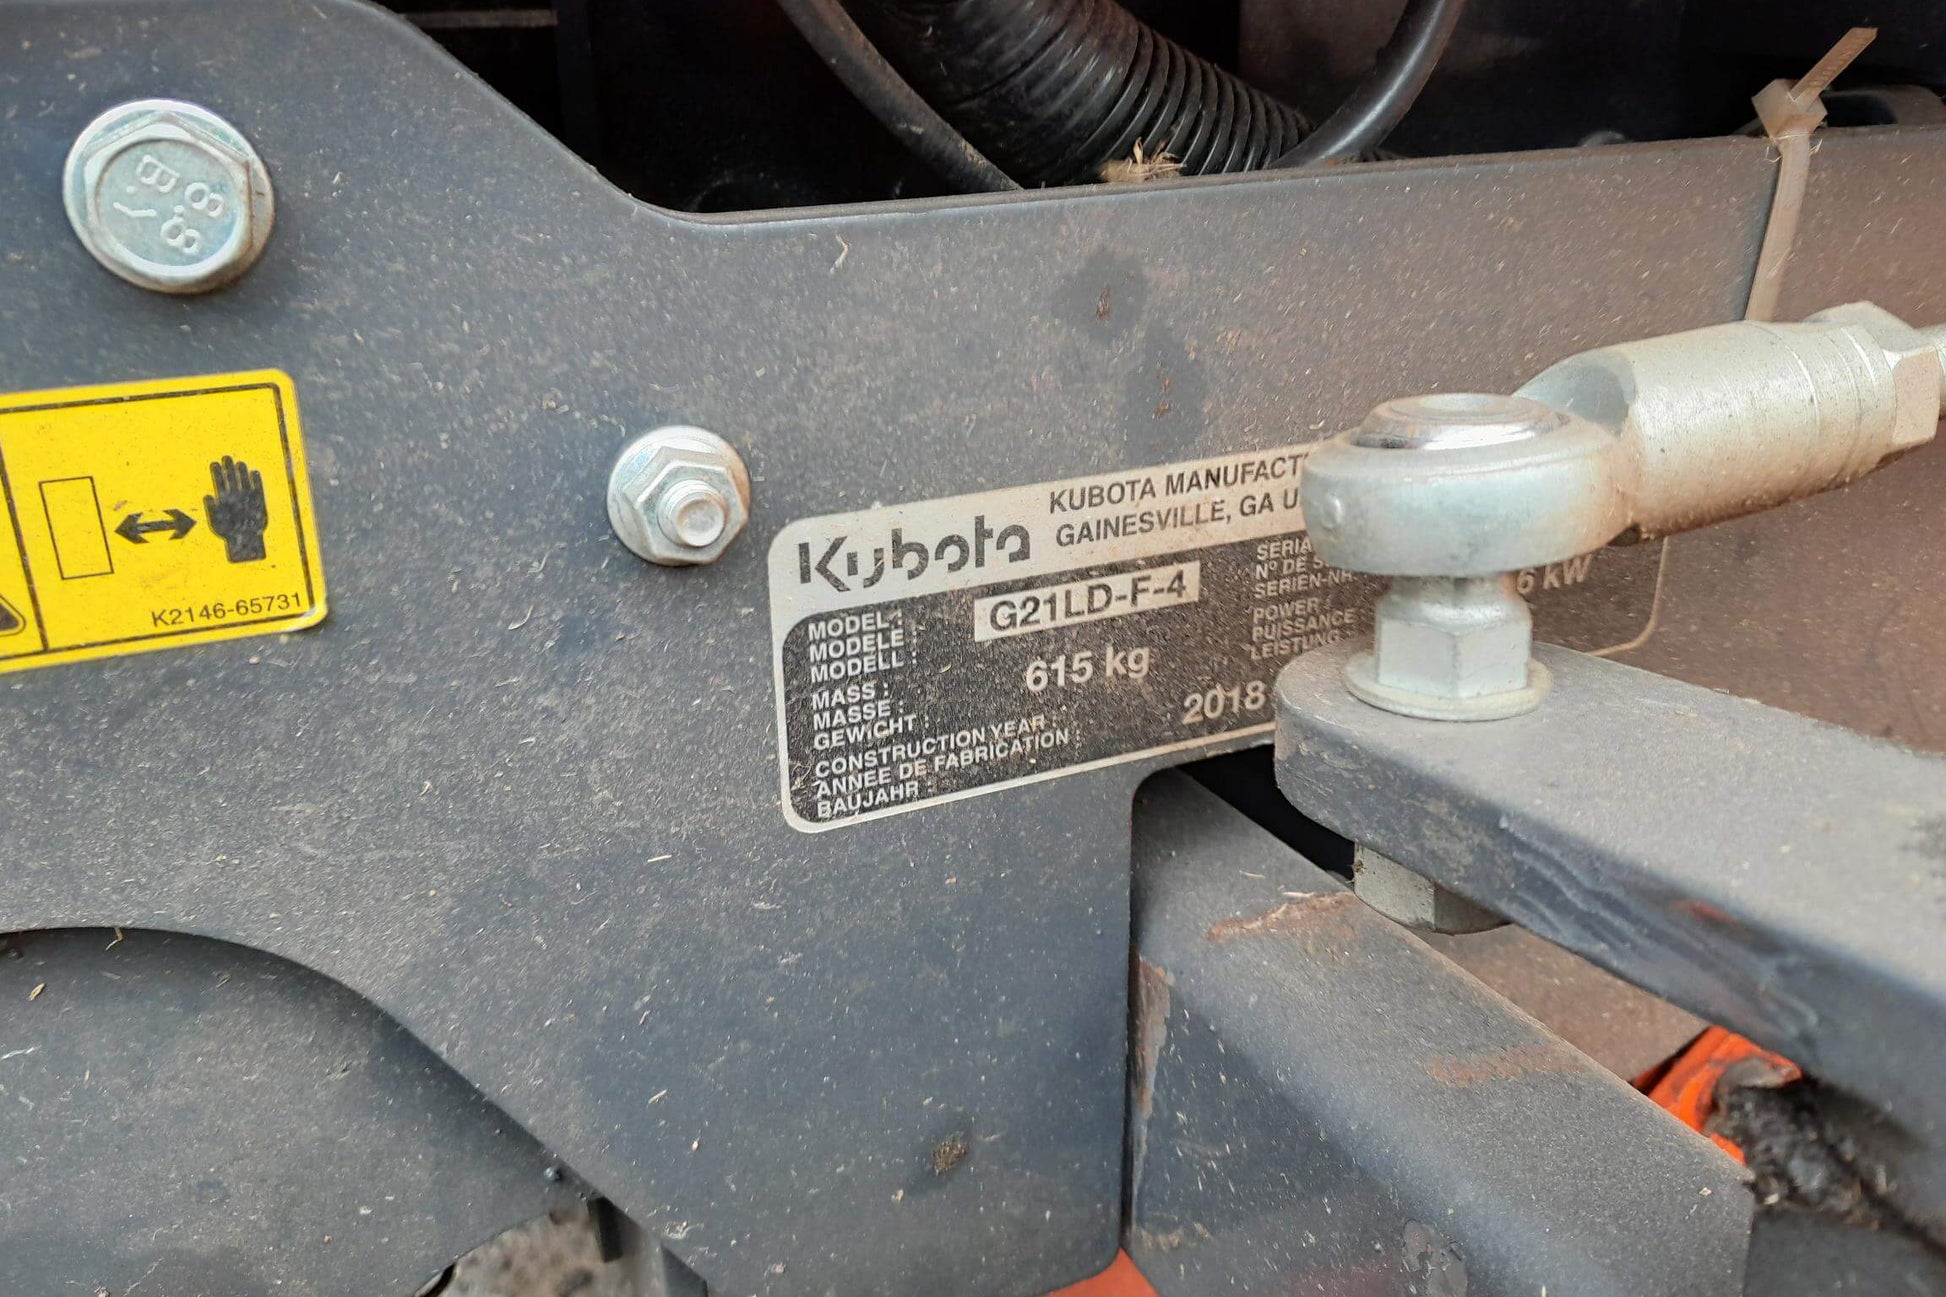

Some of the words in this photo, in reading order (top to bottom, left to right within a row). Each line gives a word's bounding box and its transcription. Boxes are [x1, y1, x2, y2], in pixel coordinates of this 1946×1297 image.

[161, 181, 224, 255] 8.8
[1049, 478, 1156, 514] KUBOTA
[1164, 451, 1308, 497] MANUFACT
[1056, 500, 1231, 547] GAINESVILLE,
[1239, 492, 1274, 517] GA
[798, 514, 1031, 593] Kubota
[1282, 555, 1307, 576] DE
[150, 592, 301, 628] K2146-65731
[989, 568, 1187, 633] G21LD-F-4
[1253, 597, 1320, 625] POWER
[808, 610, 890, 642] MODEL
[1251, 607, 1356, 642] PUISSANCE
[1250, 630, 1341, 661] LEISTUNG
[811, 651, 905, 684] MODELL
[1025, 650, 1094, 694] 615
[1104, 645, 1150, 680] kg
[812, 682, 876, 711] MASS
[813, 699, 892, 731] MASSE
[1181, 680, 1267, 726] 2018
[814, 714, 917, 751] GEWICHT
[815, 726, 986, 779] CONSTRUCTION
[989, 713, 1046, 740] YEAR
[816, 766, 892, 800] ANNEE
[899, 758, 928, 780] DE
[934, 727, 1070, 773] FABRICATION
[816, 781, 919, 819] BAUJAHR
